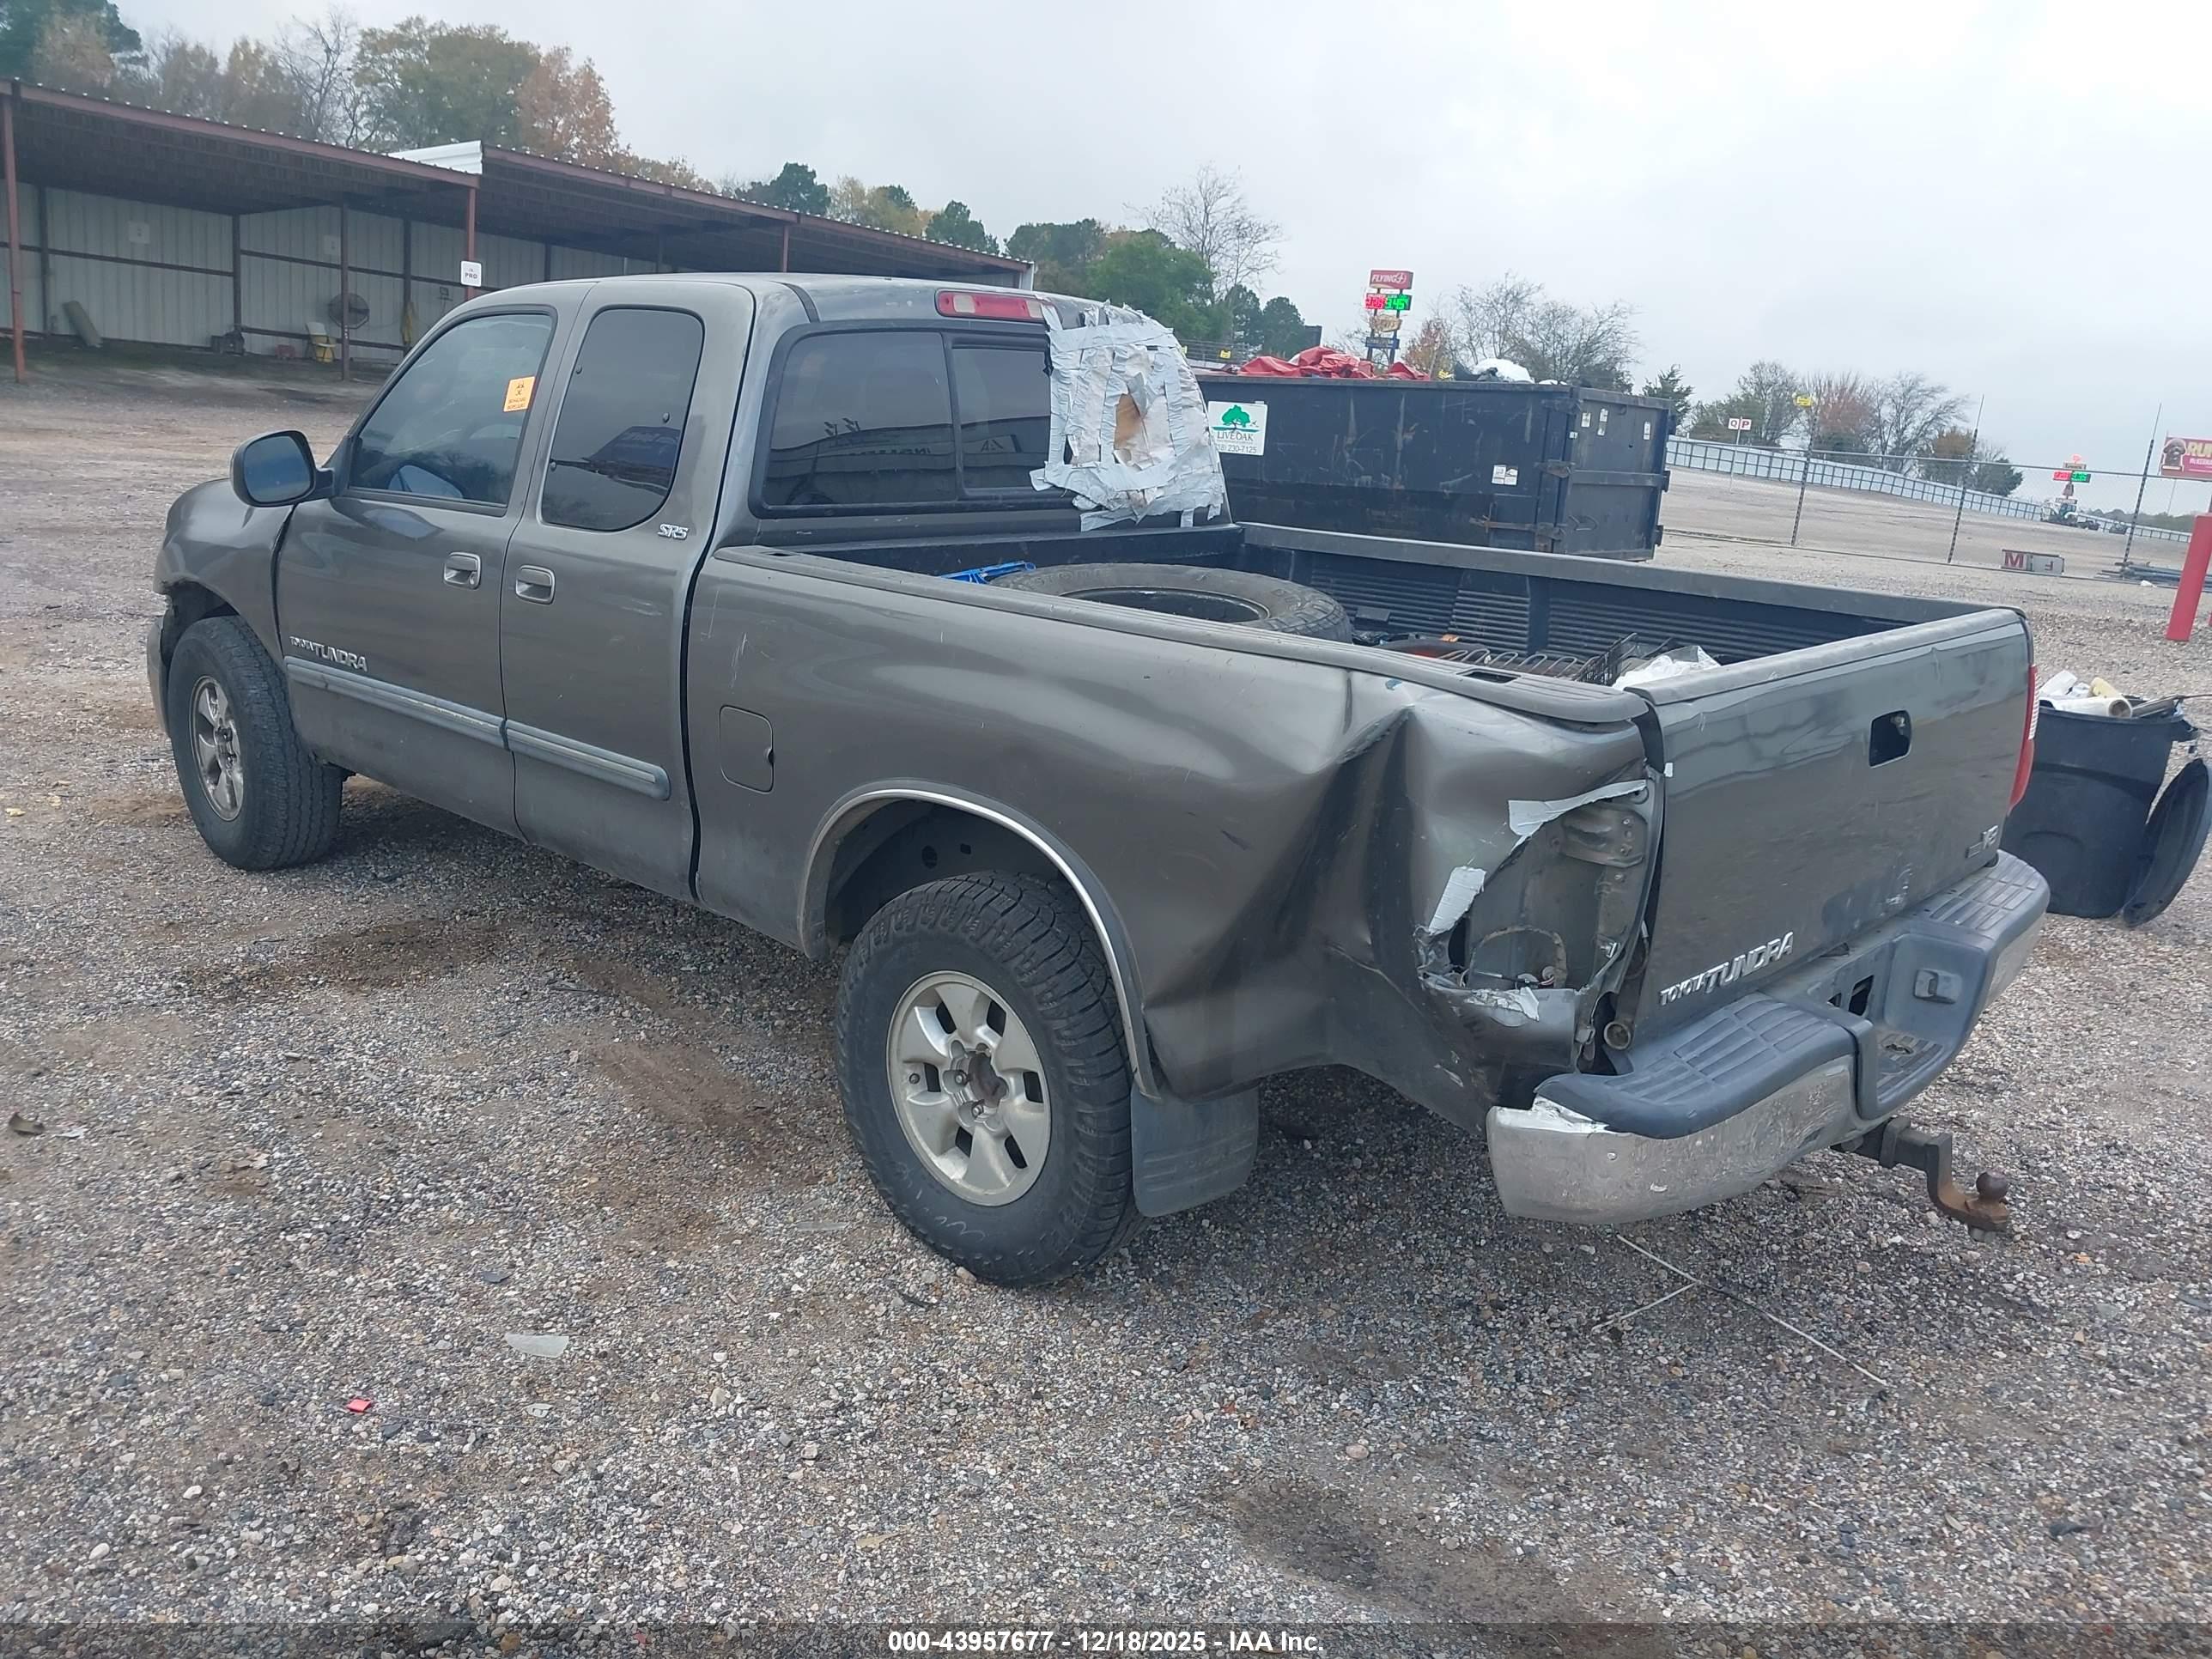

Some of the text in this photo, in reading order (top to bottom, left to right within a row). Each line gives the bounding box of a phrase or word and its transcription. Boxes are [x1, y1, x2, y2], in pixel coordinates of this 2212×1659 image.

[1372, 274, 1396, 283] FLYING
[1217, 431, 1254, 441] LIVE OAK
[1228, 445, 1257, 453] 230-7125
[658, 524, 689, 539] SR5
[2004, 550, 2024, 568] M
[289, 636, 368, 672] TOYOTA TUNDRA
[1660, 931, 1794, 1006] TOYOTA TUNDRA
